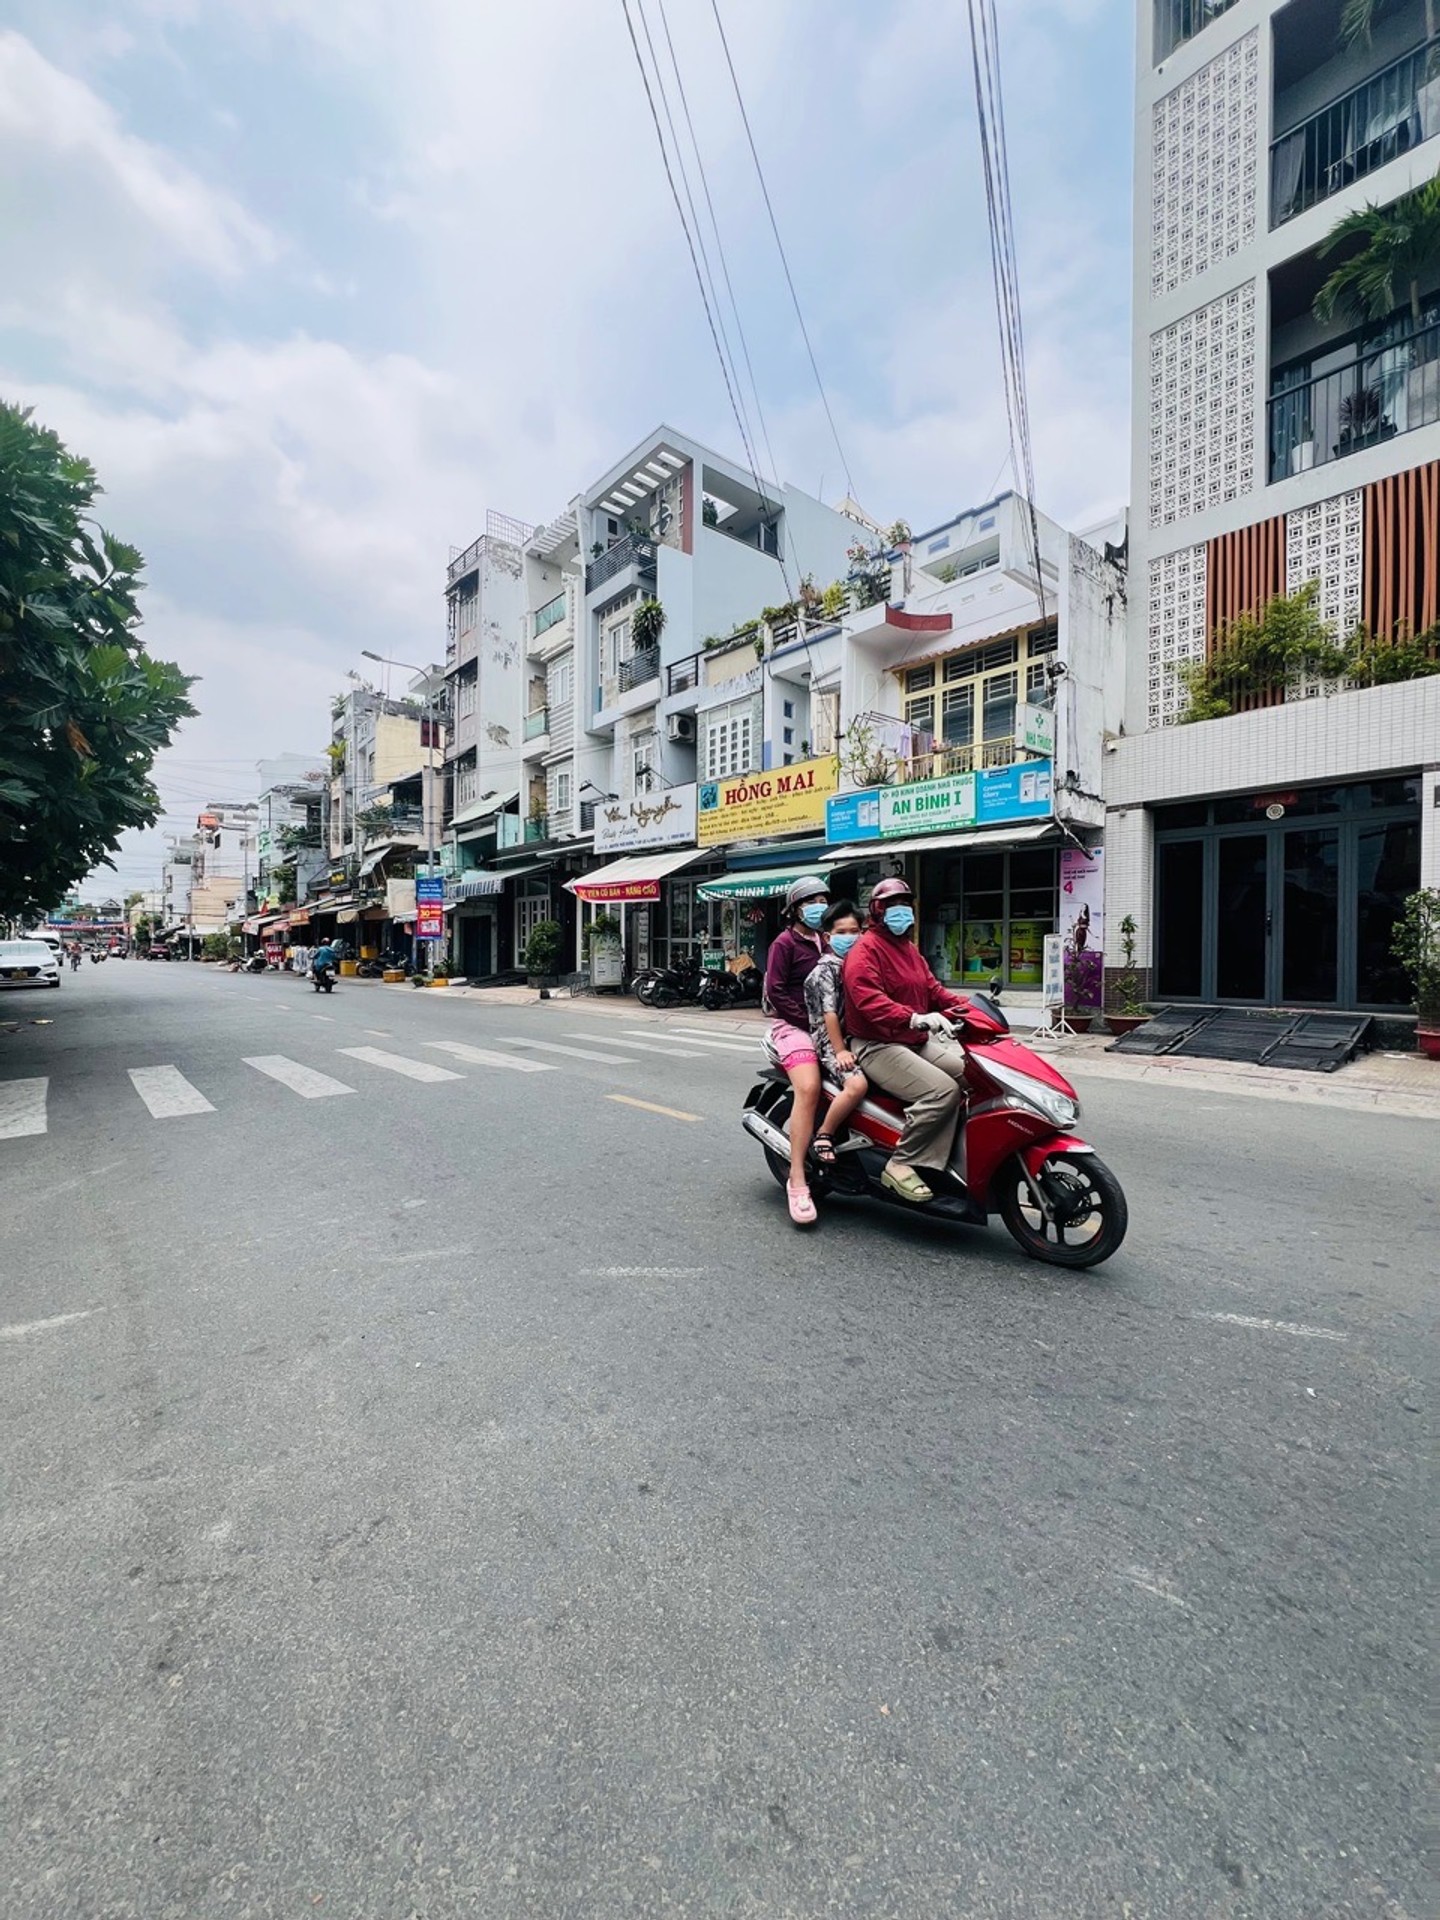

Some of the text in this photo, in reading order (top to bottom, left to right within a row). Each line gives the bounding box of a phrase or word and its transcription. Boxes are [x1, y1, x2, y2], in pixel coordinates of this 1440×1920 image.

[725, 770, 814, 805] HỒNG MAI
[892, 791, 961, 815] AN BÌNH I
